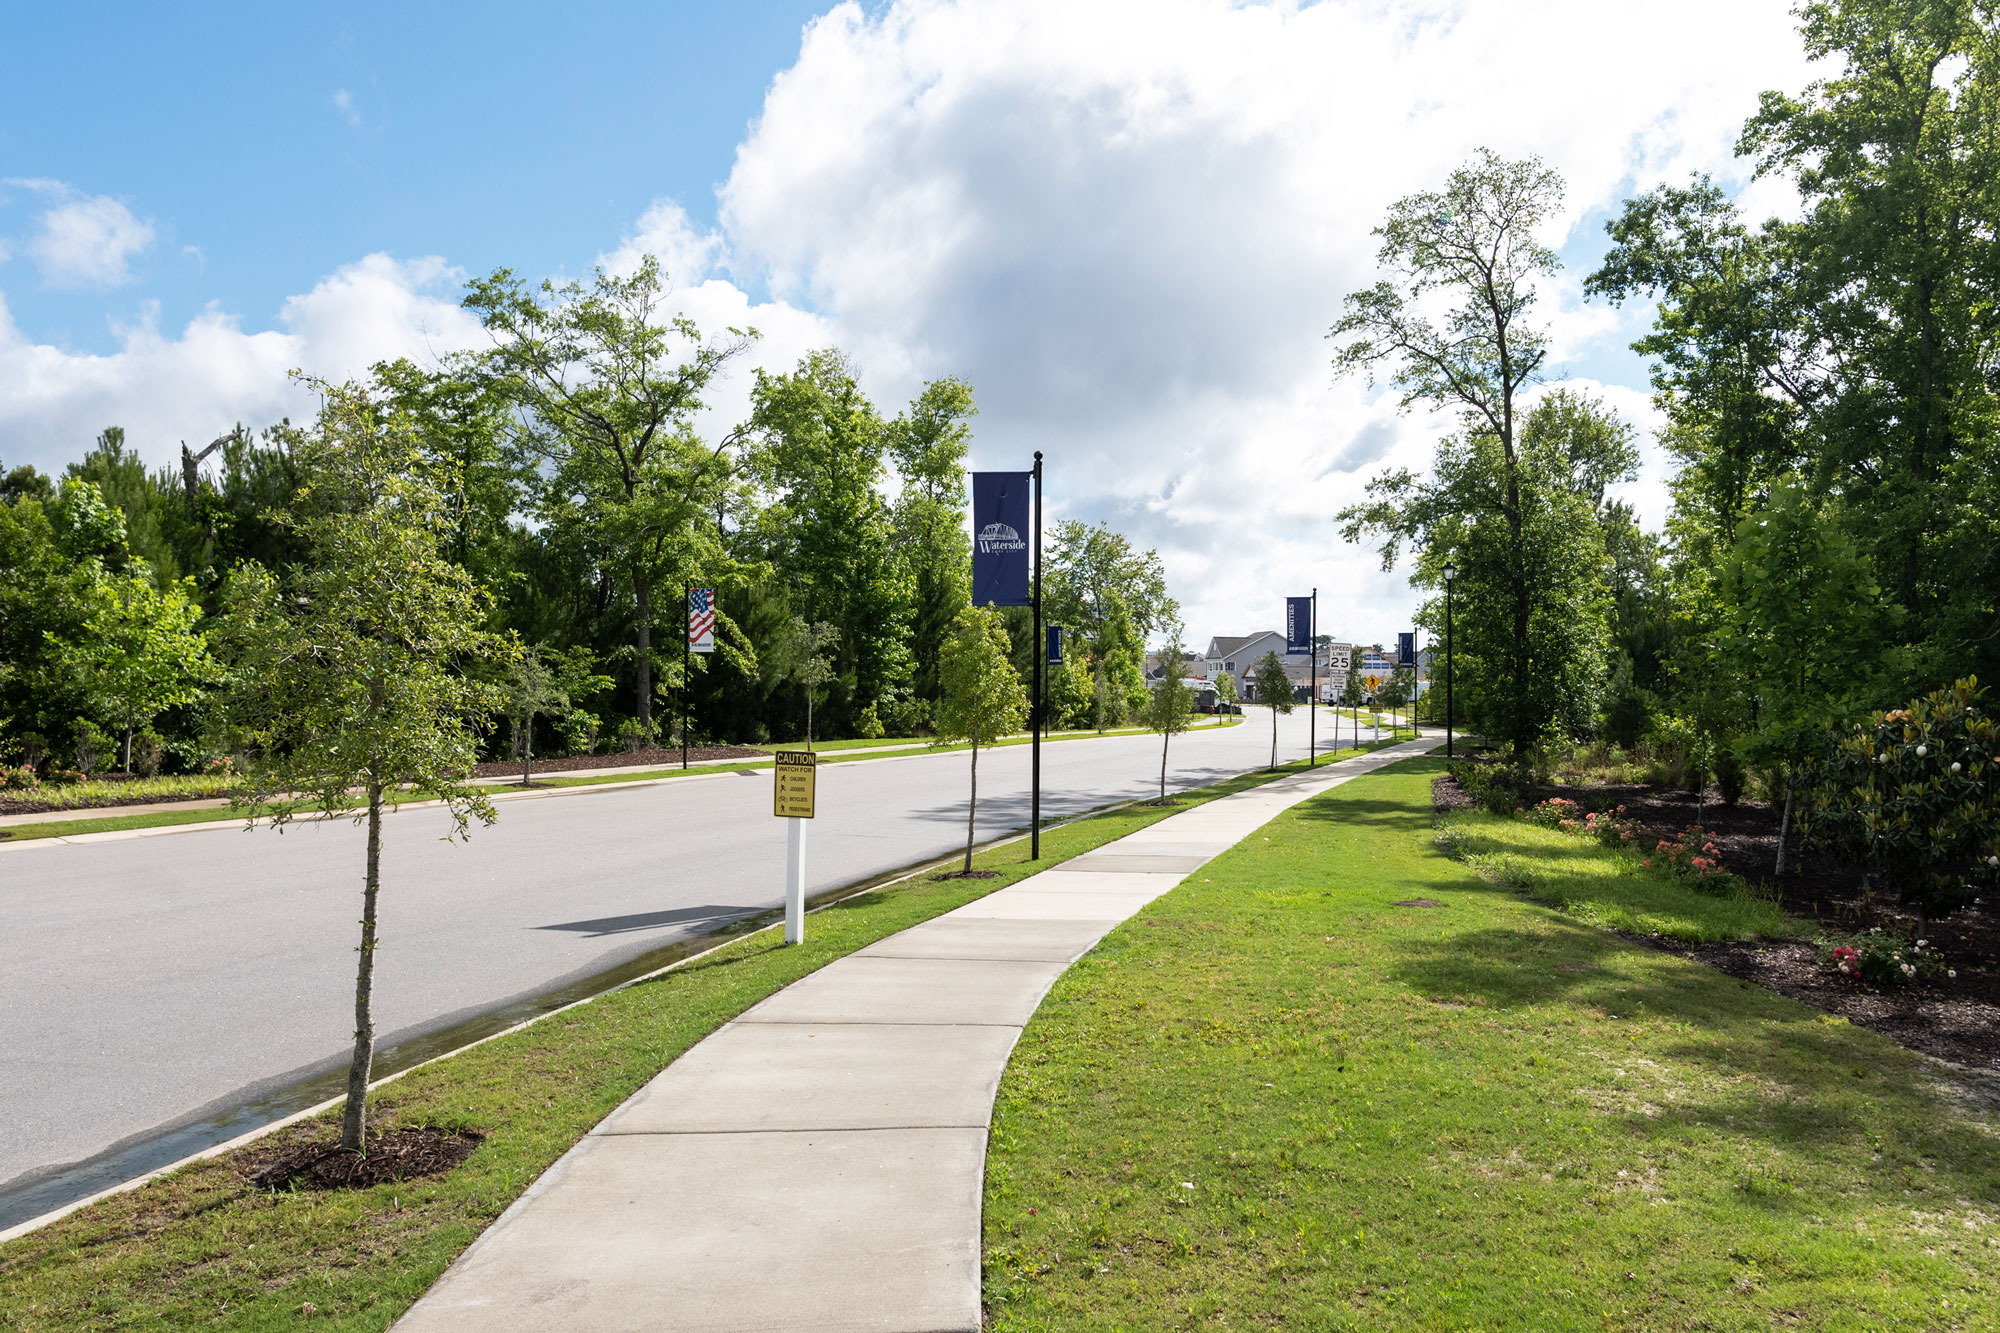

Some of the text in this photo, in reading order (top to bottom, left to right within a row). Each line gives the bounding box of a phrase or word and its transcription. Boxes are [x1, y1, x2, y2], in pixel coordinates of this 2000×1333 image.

[979, 539, 1026, 553] Waterside
[1331, 657, 1349, 668] 25
[777, 752, 814, 764] CAUTION
